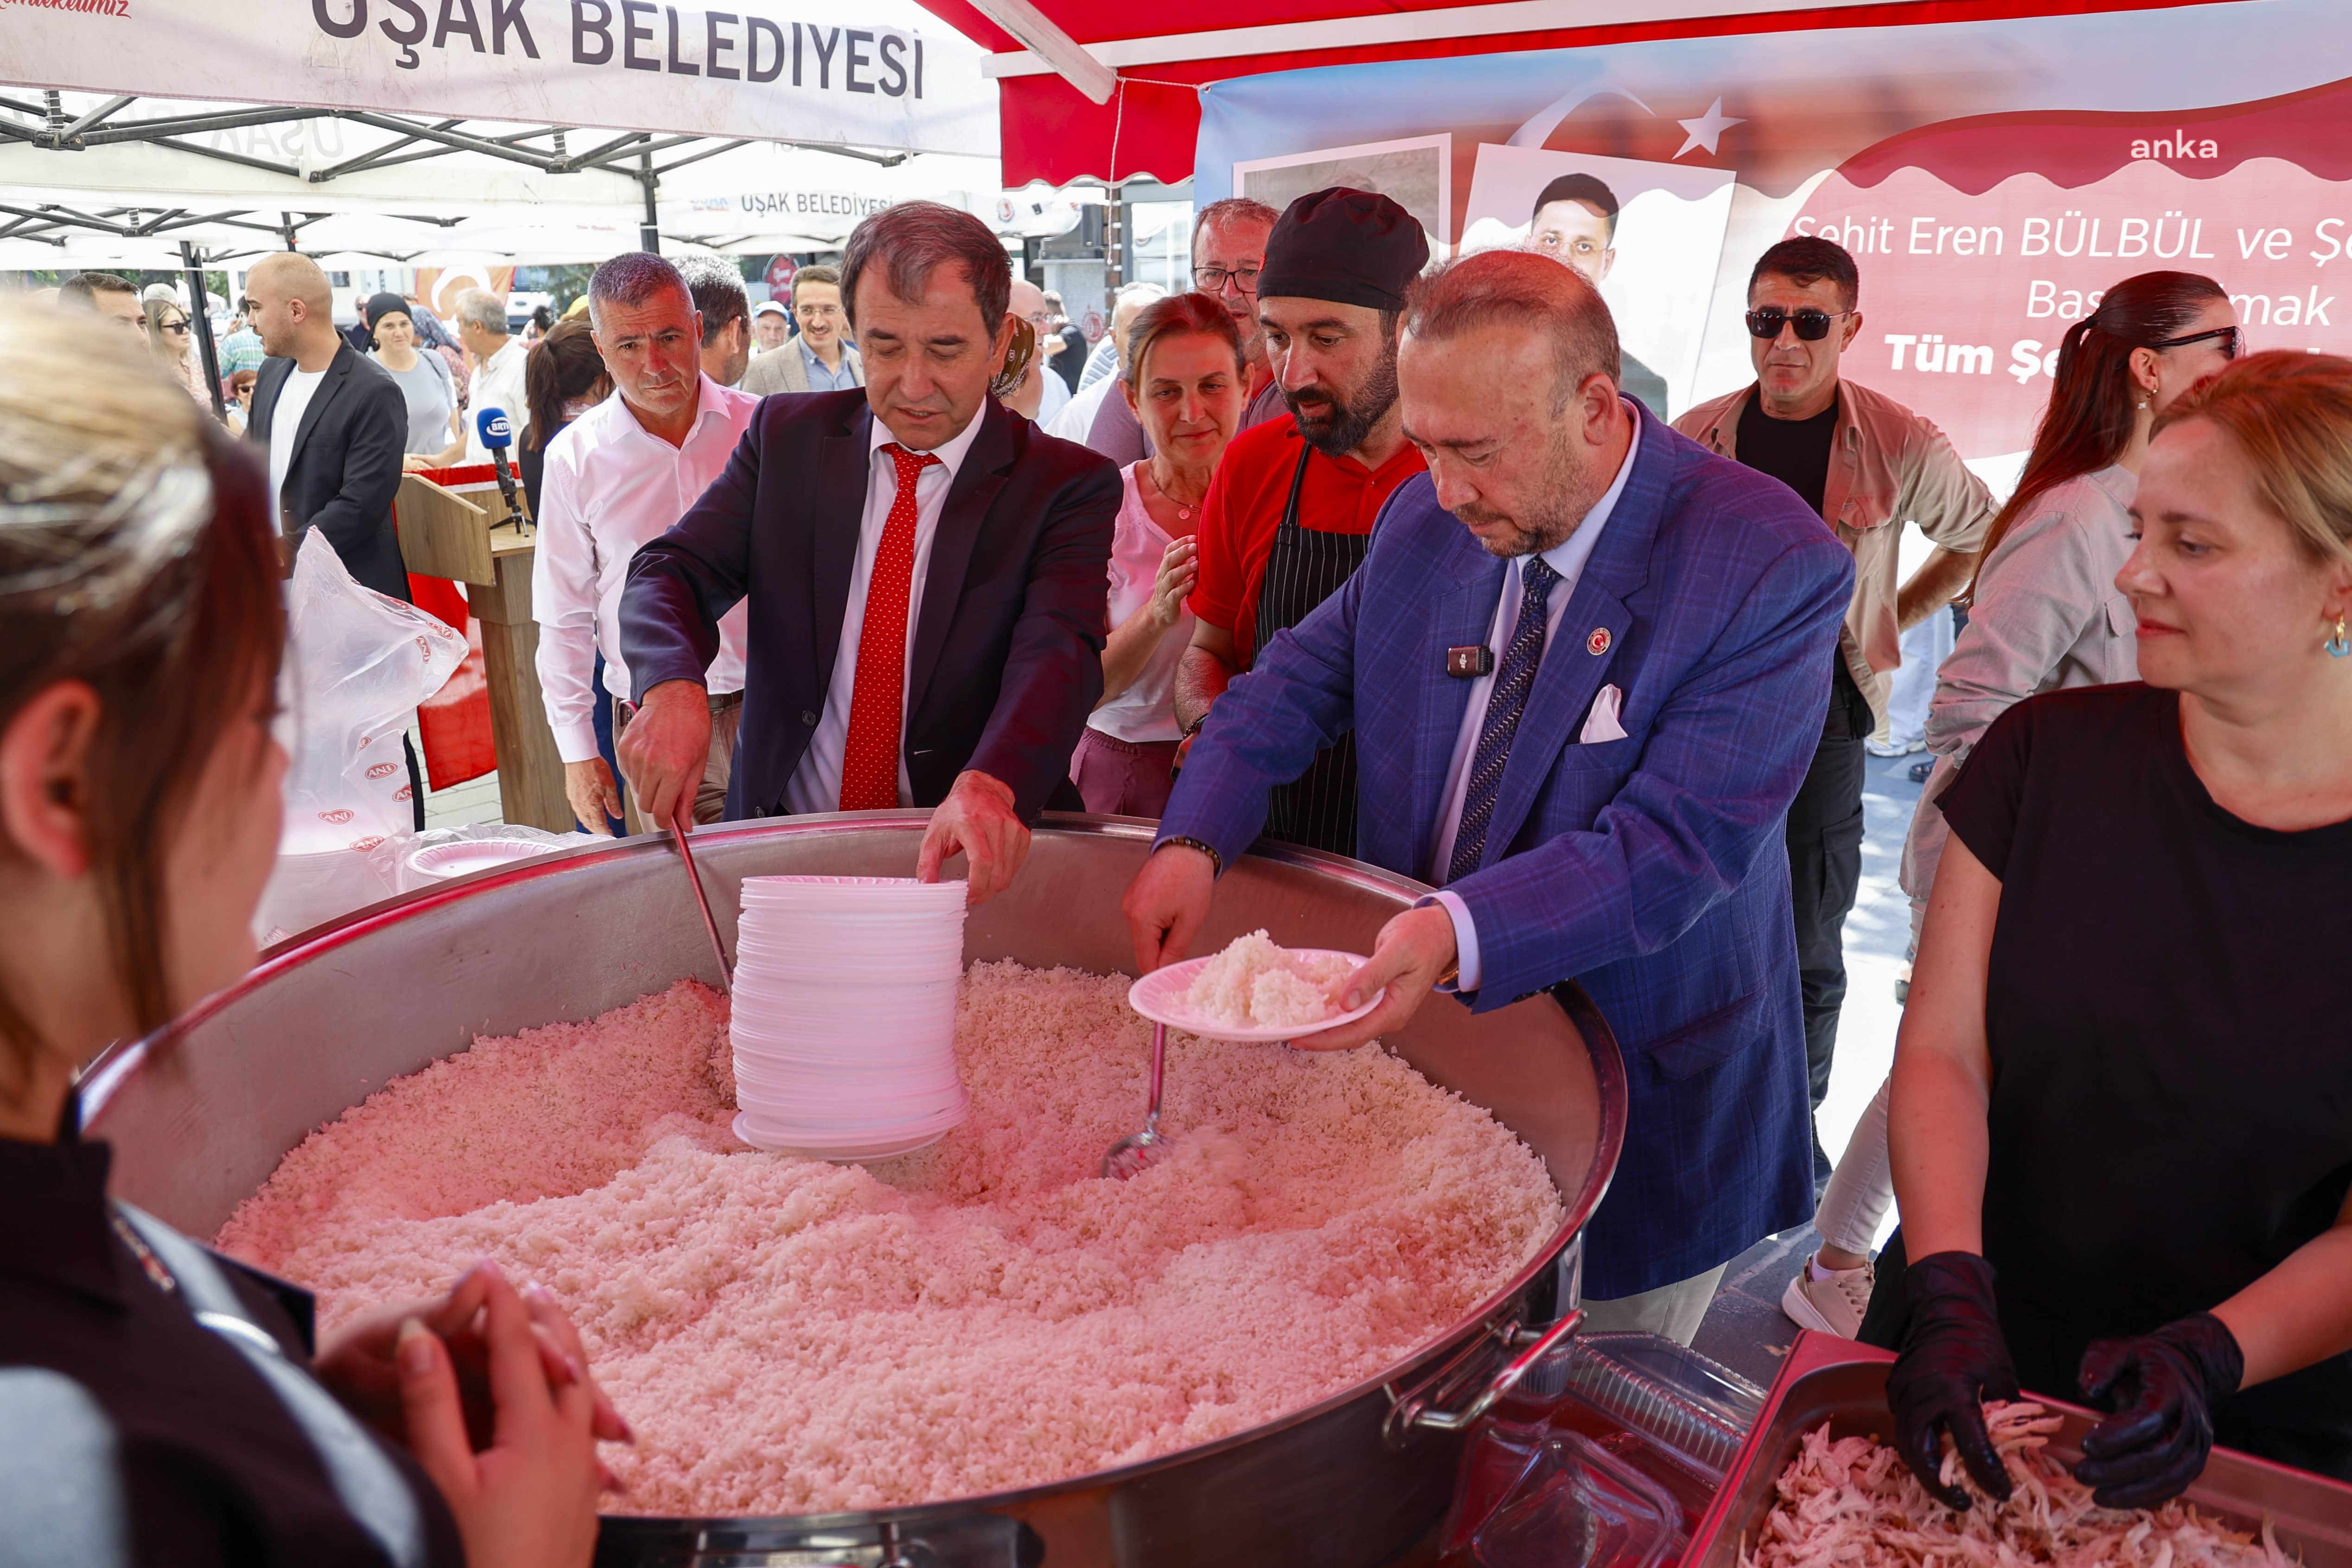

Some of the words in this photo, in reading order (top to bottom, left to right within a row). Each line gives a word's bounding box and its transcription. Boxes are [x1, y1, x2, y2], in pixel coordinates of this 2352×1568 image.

[742, 193, 790, 217] UŞAK
[1908, 217, 2003, 255] Eren
[2020, 210, 2215, 258] BÜLBÜL
[2237, 227, 2292, 260] ve
[1884, 334, 1994, 375] Tüm
[367, 765, 392, 778] ANI
[396, 789, 413, 800] AN
[324, 812, 348, 822] ANI
